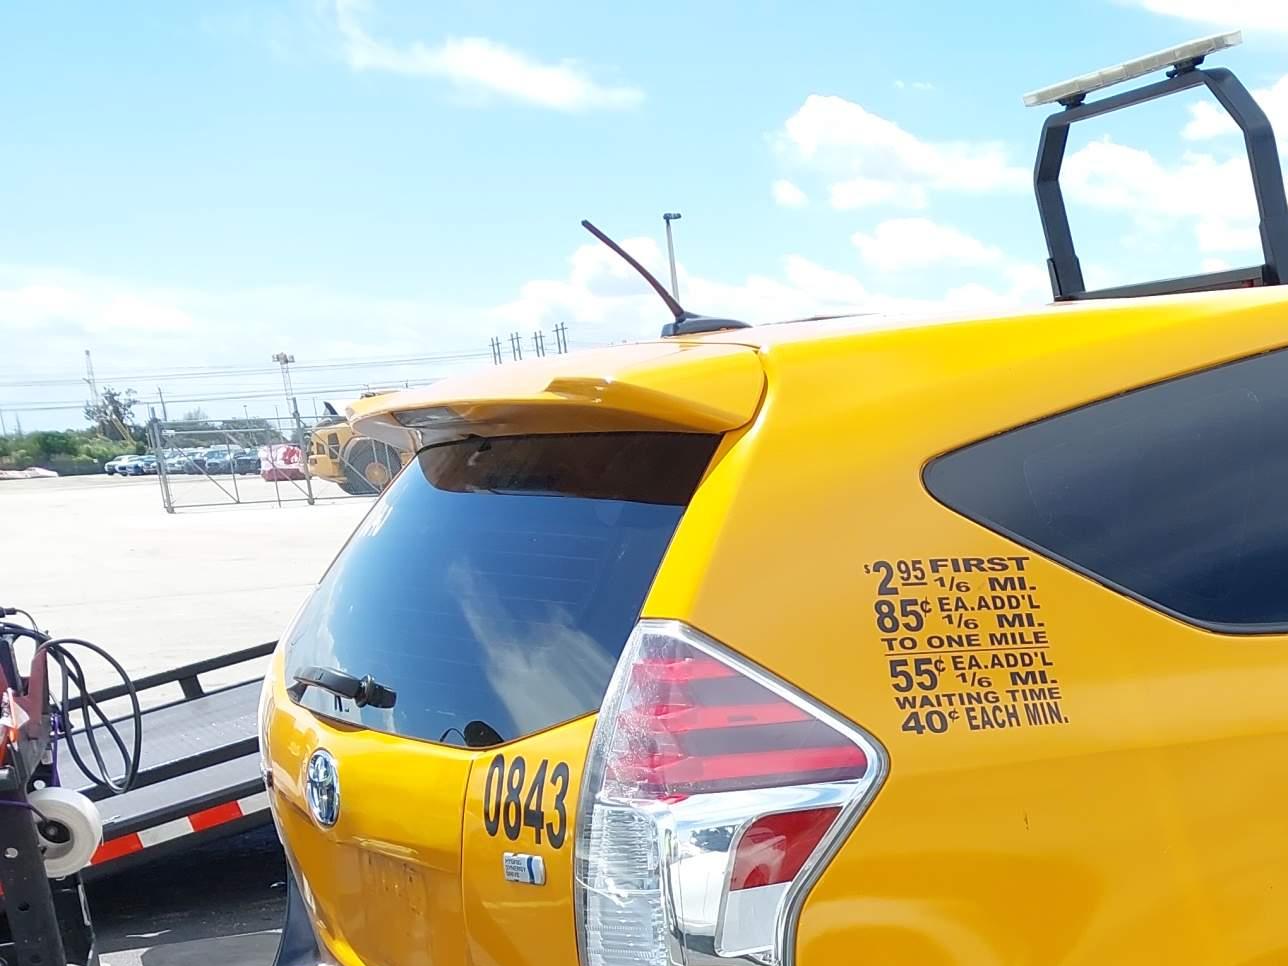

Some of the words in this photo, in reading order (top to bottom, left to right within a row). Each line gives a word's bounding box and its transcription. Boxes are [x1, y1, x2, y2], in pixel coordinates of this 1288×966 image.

[929, 556, 1030, 573] FIRST
[934, 576, 971, 593] 1/6
[988, 576, 1037, 592] MI.
[874, 597, 933, 634] 85¢
[942, 613, 979, 630] 1/6
[996, 612, 1045, 628] MI.
[880, 636, 918, 652] TO
[926, 633, 982, 649] ONE
[989, 631, 1049, 646] MILE
[889, 656, 947, 693] 55¢
[955, 672, 992, 688] 1/6
[1010, 670, 1058, 686] MI.
[895, 691, 1000, 710] WAITING
[1006, 687, 1062, 701] TIME
[901, 708, 960, 735] 40¢
[966, 704, 1021, 731] EACH
[1026, 701, 1069, 726] MIN.
[484, 752, 570, 849] 0843
